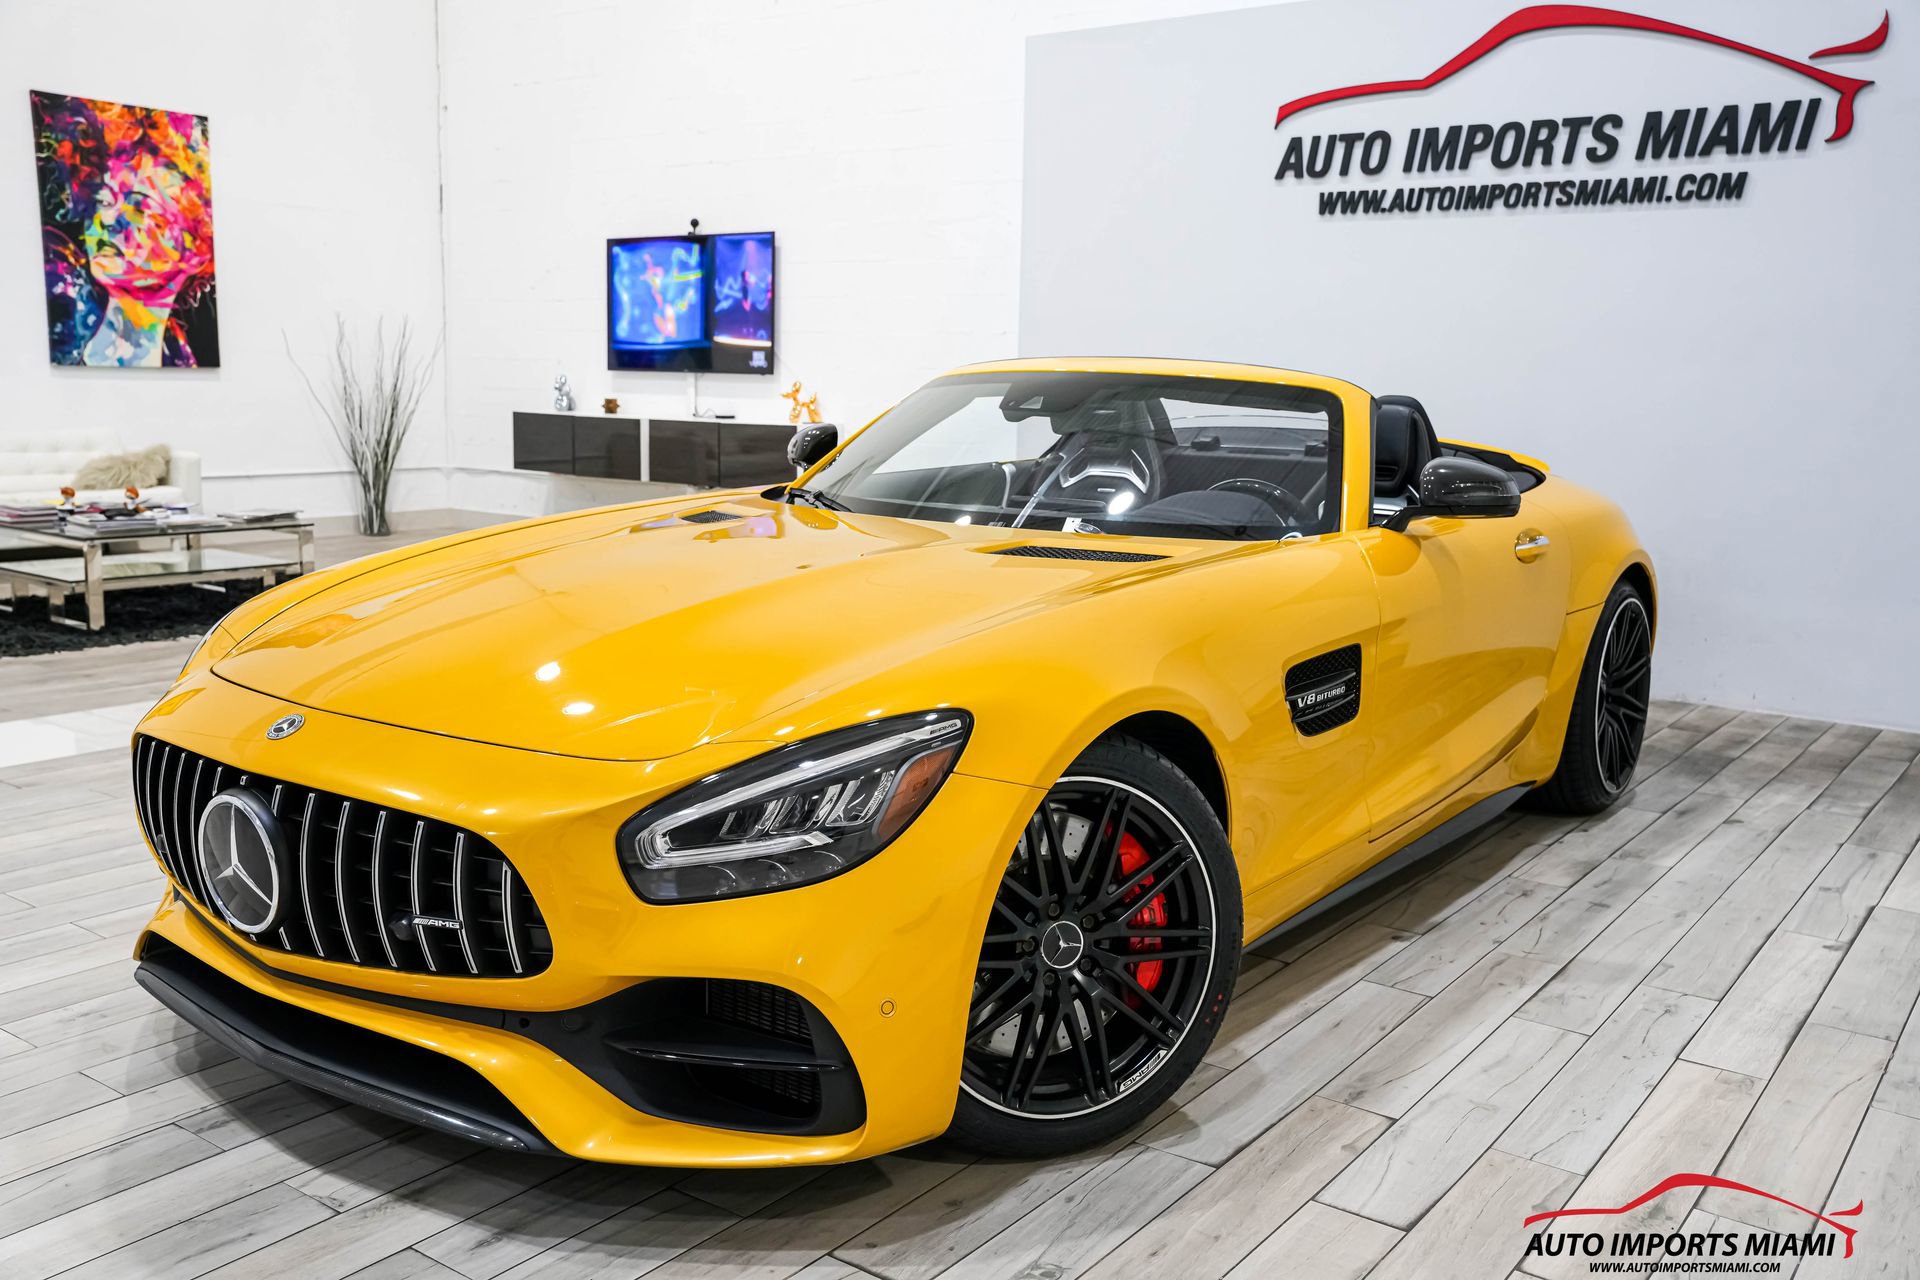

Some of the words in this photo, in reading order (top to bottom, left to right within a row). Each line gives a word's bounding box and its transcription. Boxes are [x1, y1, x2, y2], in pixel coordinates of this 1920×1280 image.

[1275, 131, 1391, 180] AUTO
[1403, 114, 1624, 174] IMPORTS
[1635, 98, 1821, 160] MIAMI
[1318, 172, 1748, 215] WWW.AUTOIMPORTSMIAMI.COM
[1297, 693, 1316, 708] V8
[1316, 685, 1346, 702] BITURBO
[427, 919, 460, 929] AMG
